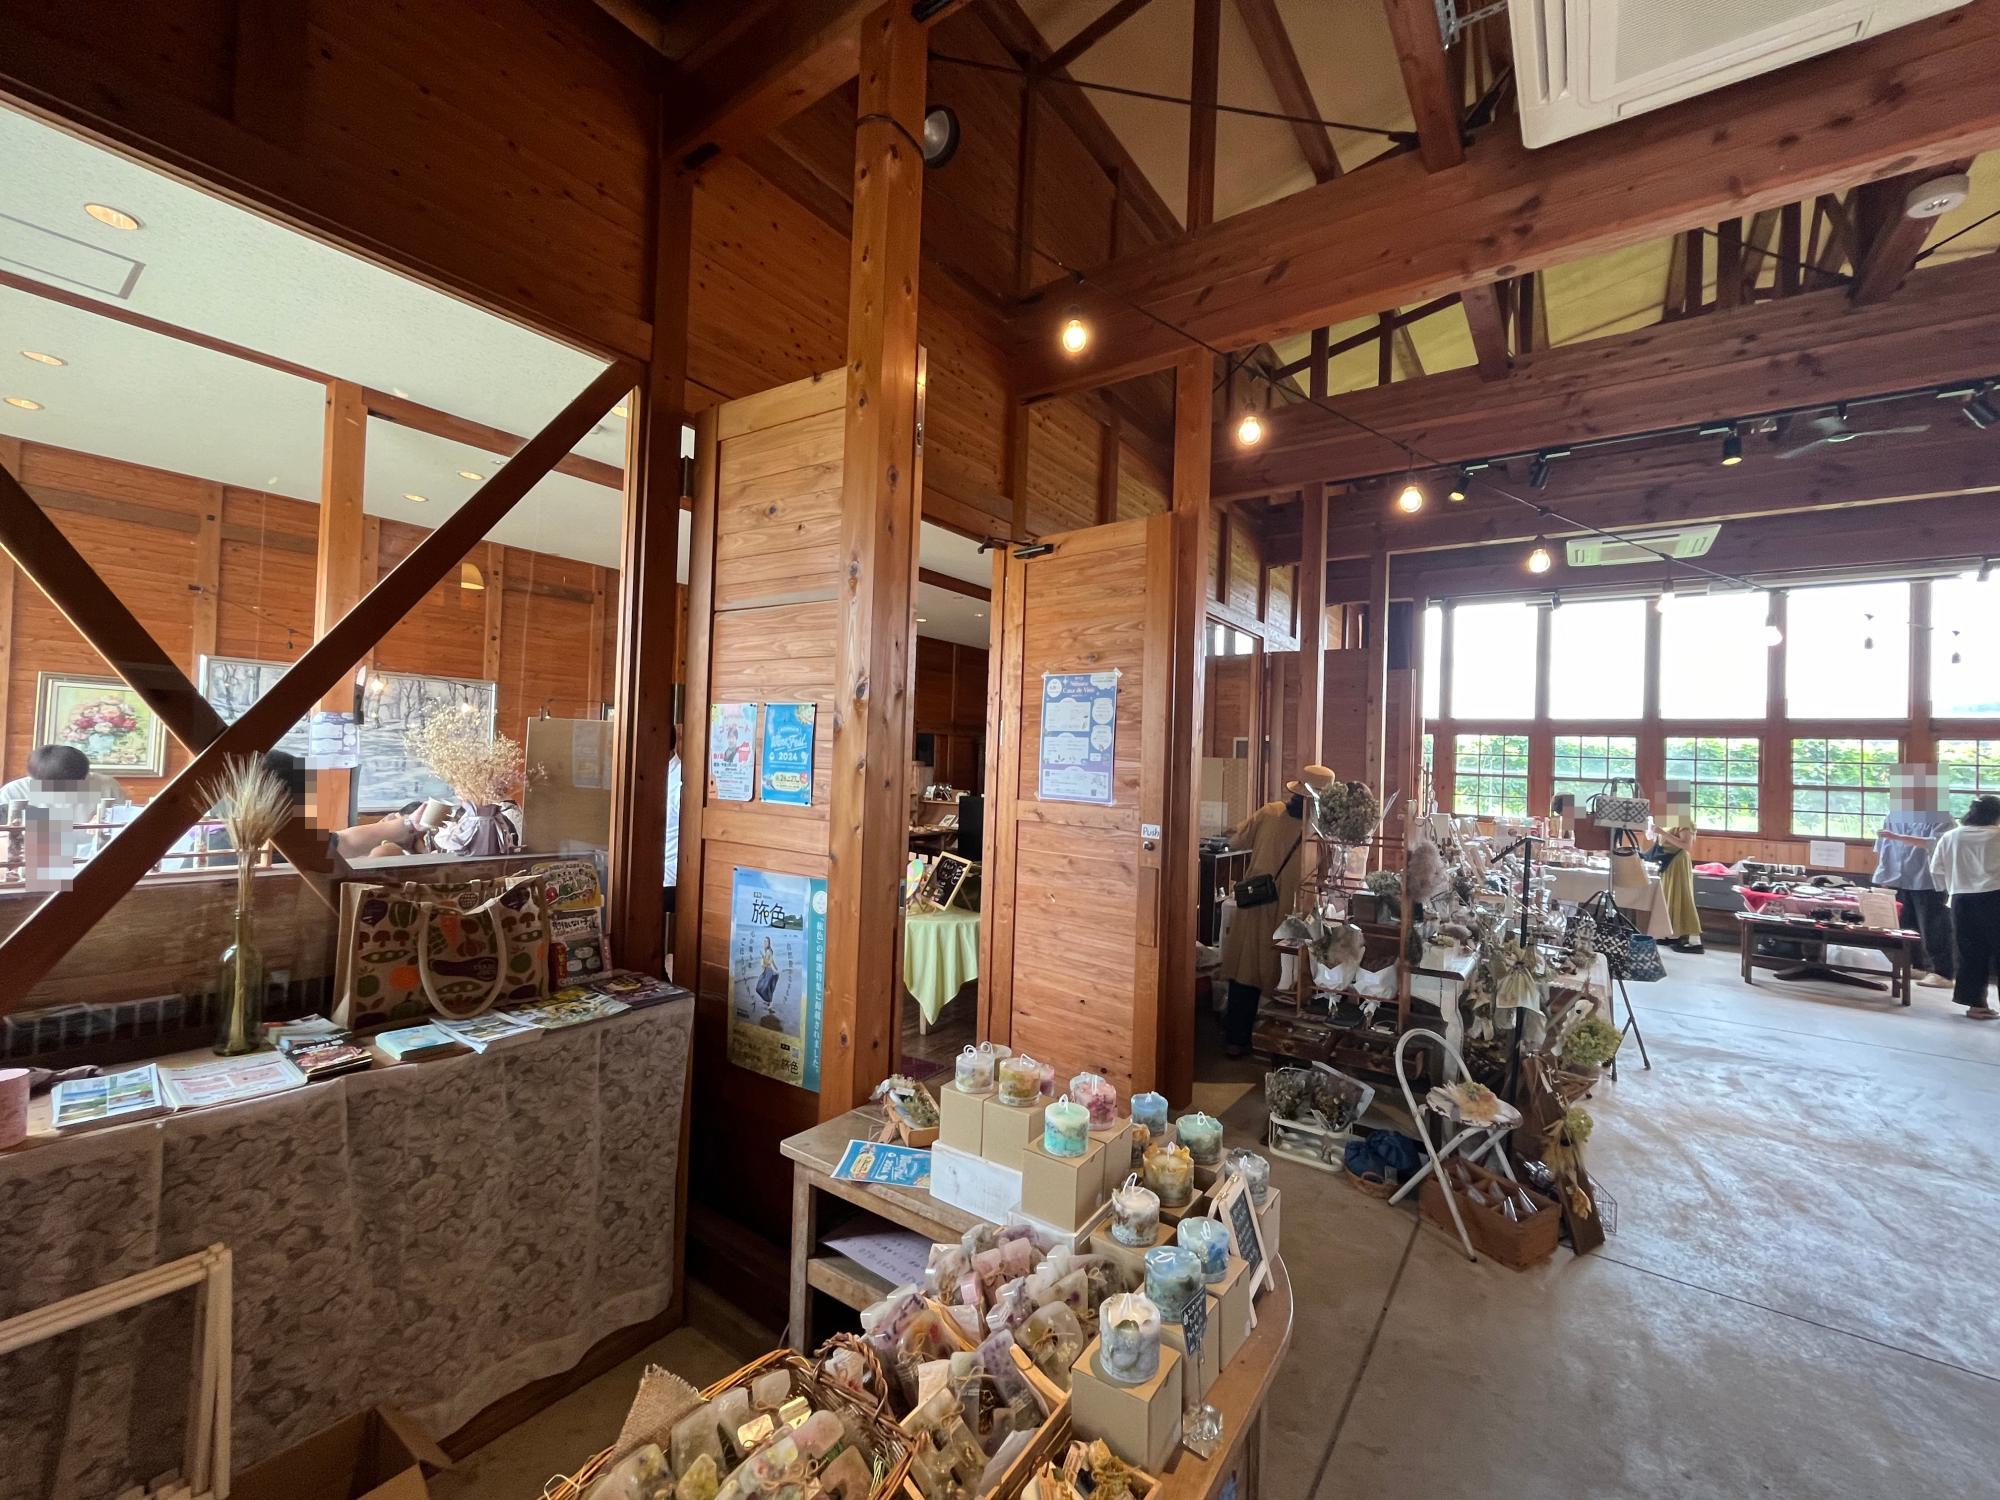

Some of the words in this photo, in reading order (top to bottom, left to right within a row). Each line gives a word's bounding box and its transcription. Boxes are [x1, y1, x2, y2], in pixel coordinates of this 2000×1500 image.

[778, 752, 798, 761] 2024
[752, 899, 786, 929] 旅色
[781, 1059, 799, 1075] 旅色
